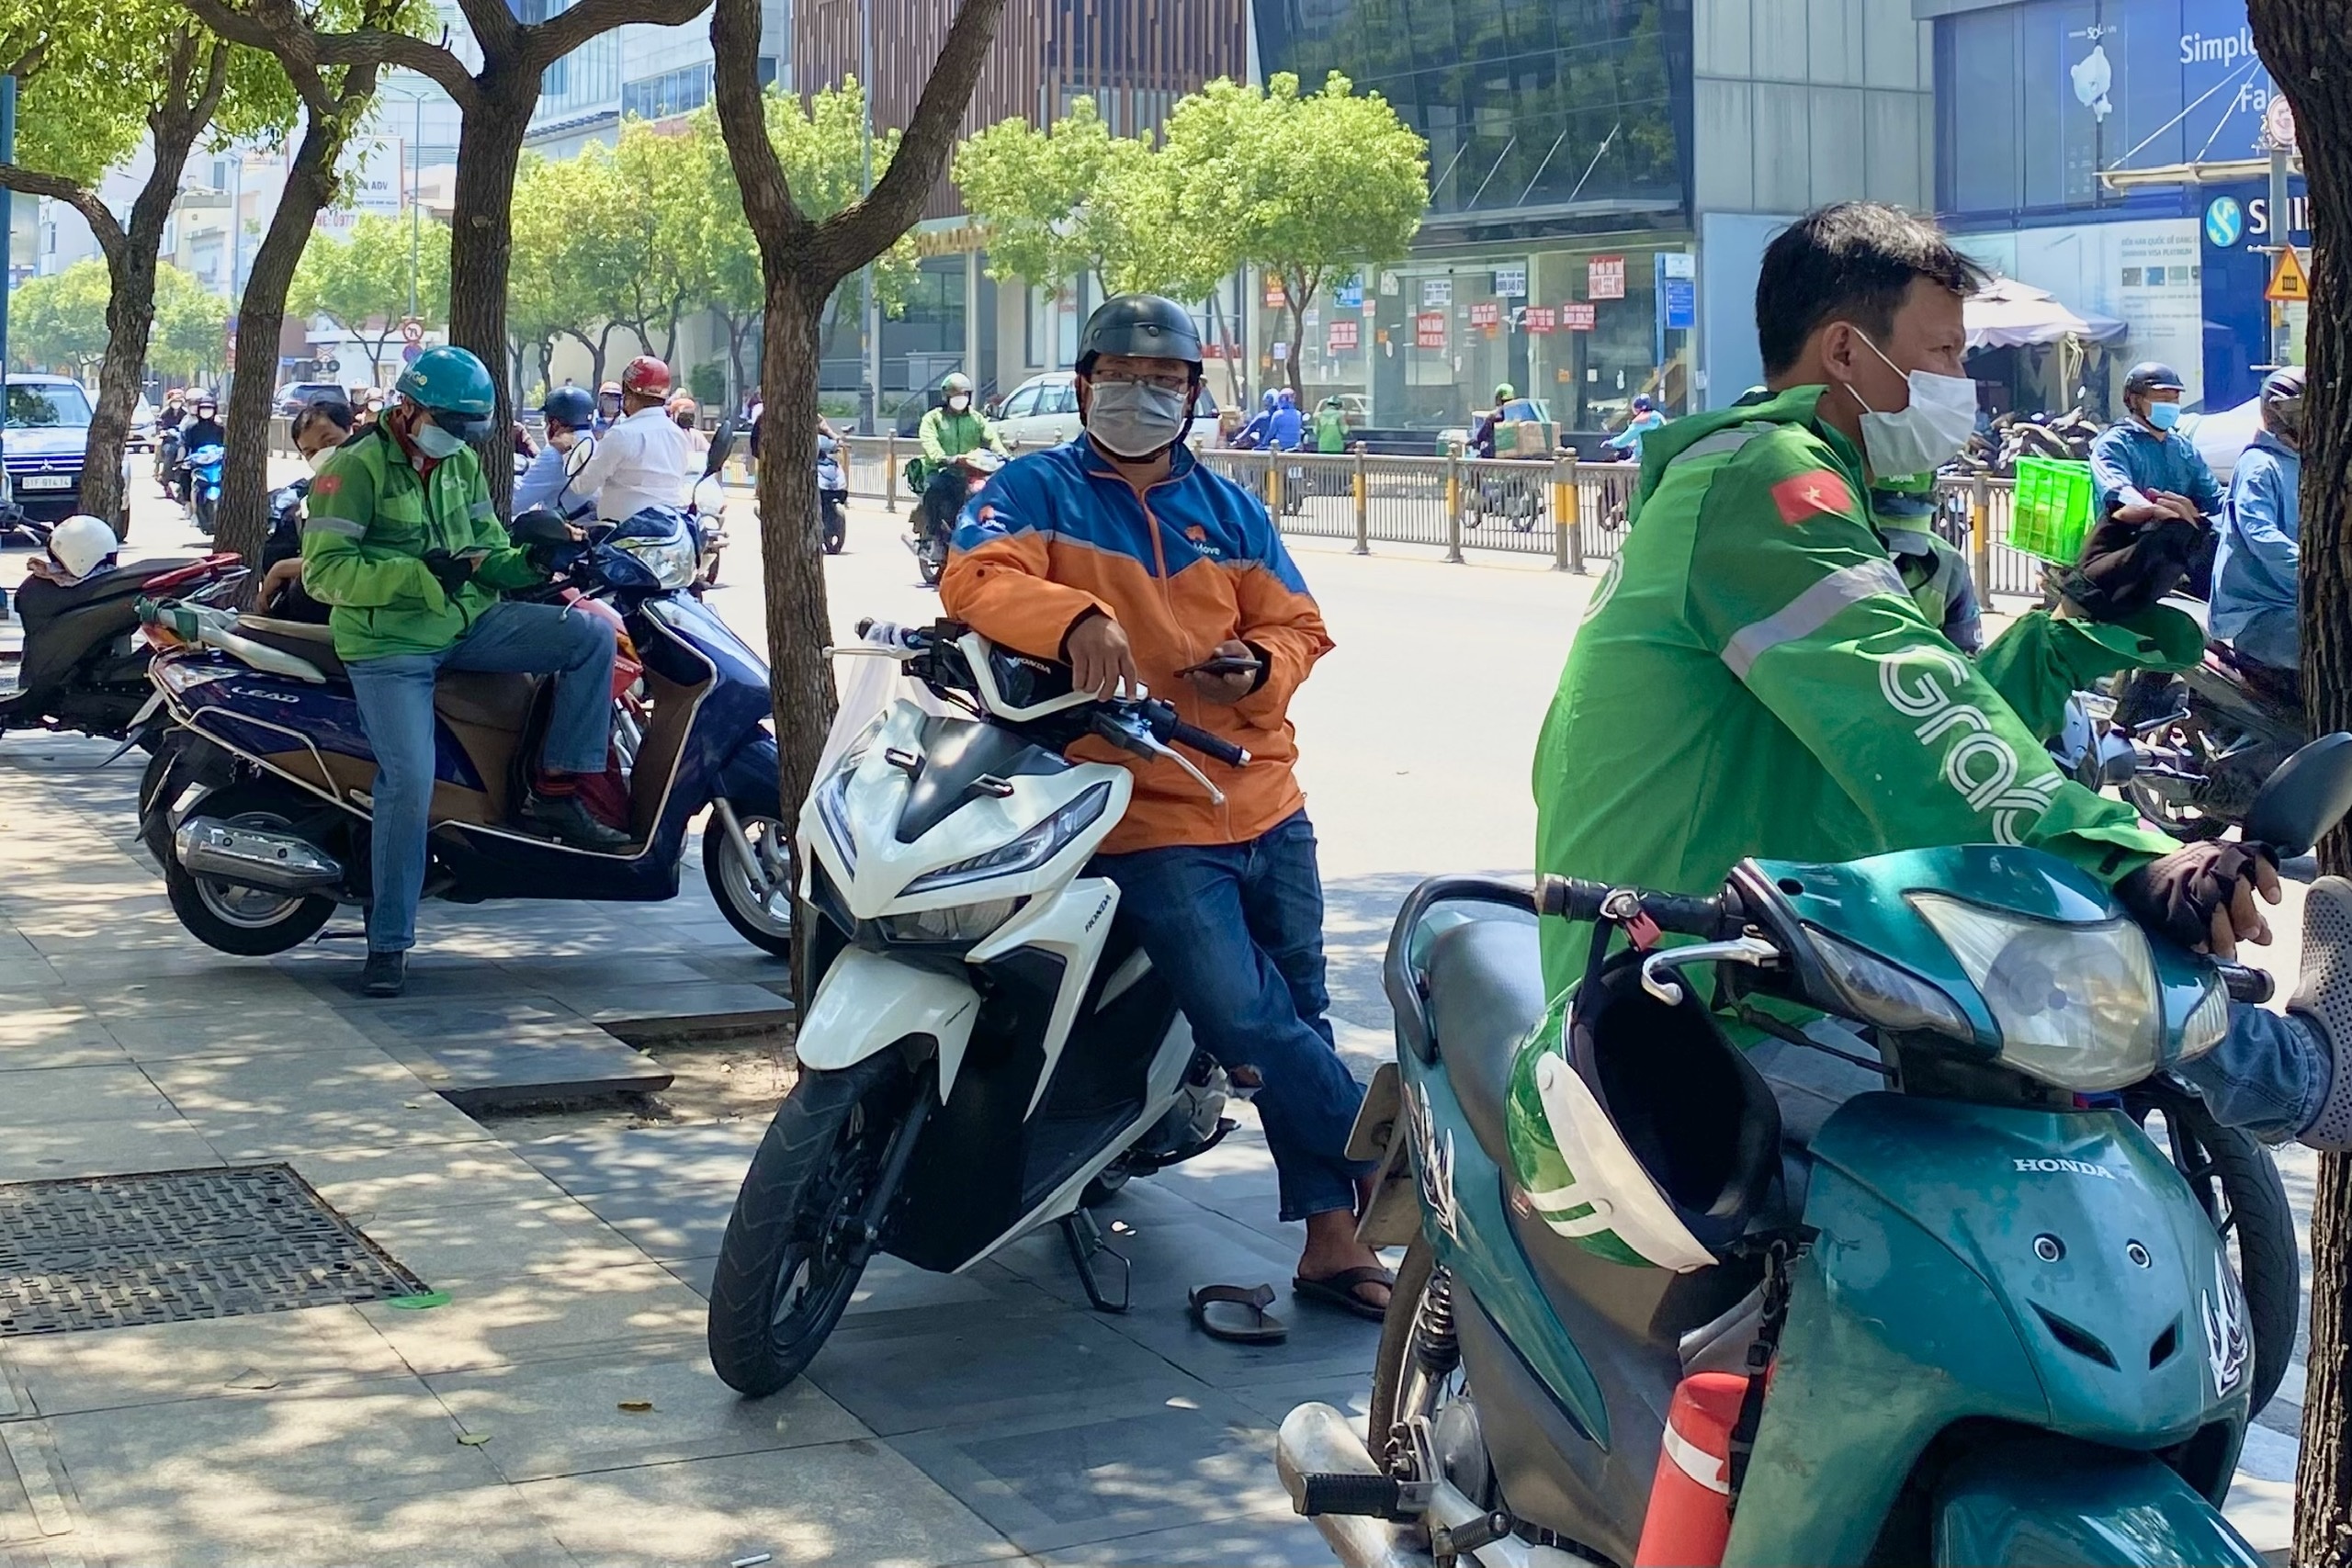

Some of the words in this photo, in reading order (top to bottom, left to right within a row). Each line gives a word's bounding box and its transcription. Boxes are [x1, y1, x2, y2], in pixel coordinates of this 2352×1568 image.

[231, 685, 301, 704] LEAD
[1084, 894, 1112, 933] HONDA
[2013, 1157, 2117, 1181] HONDA
